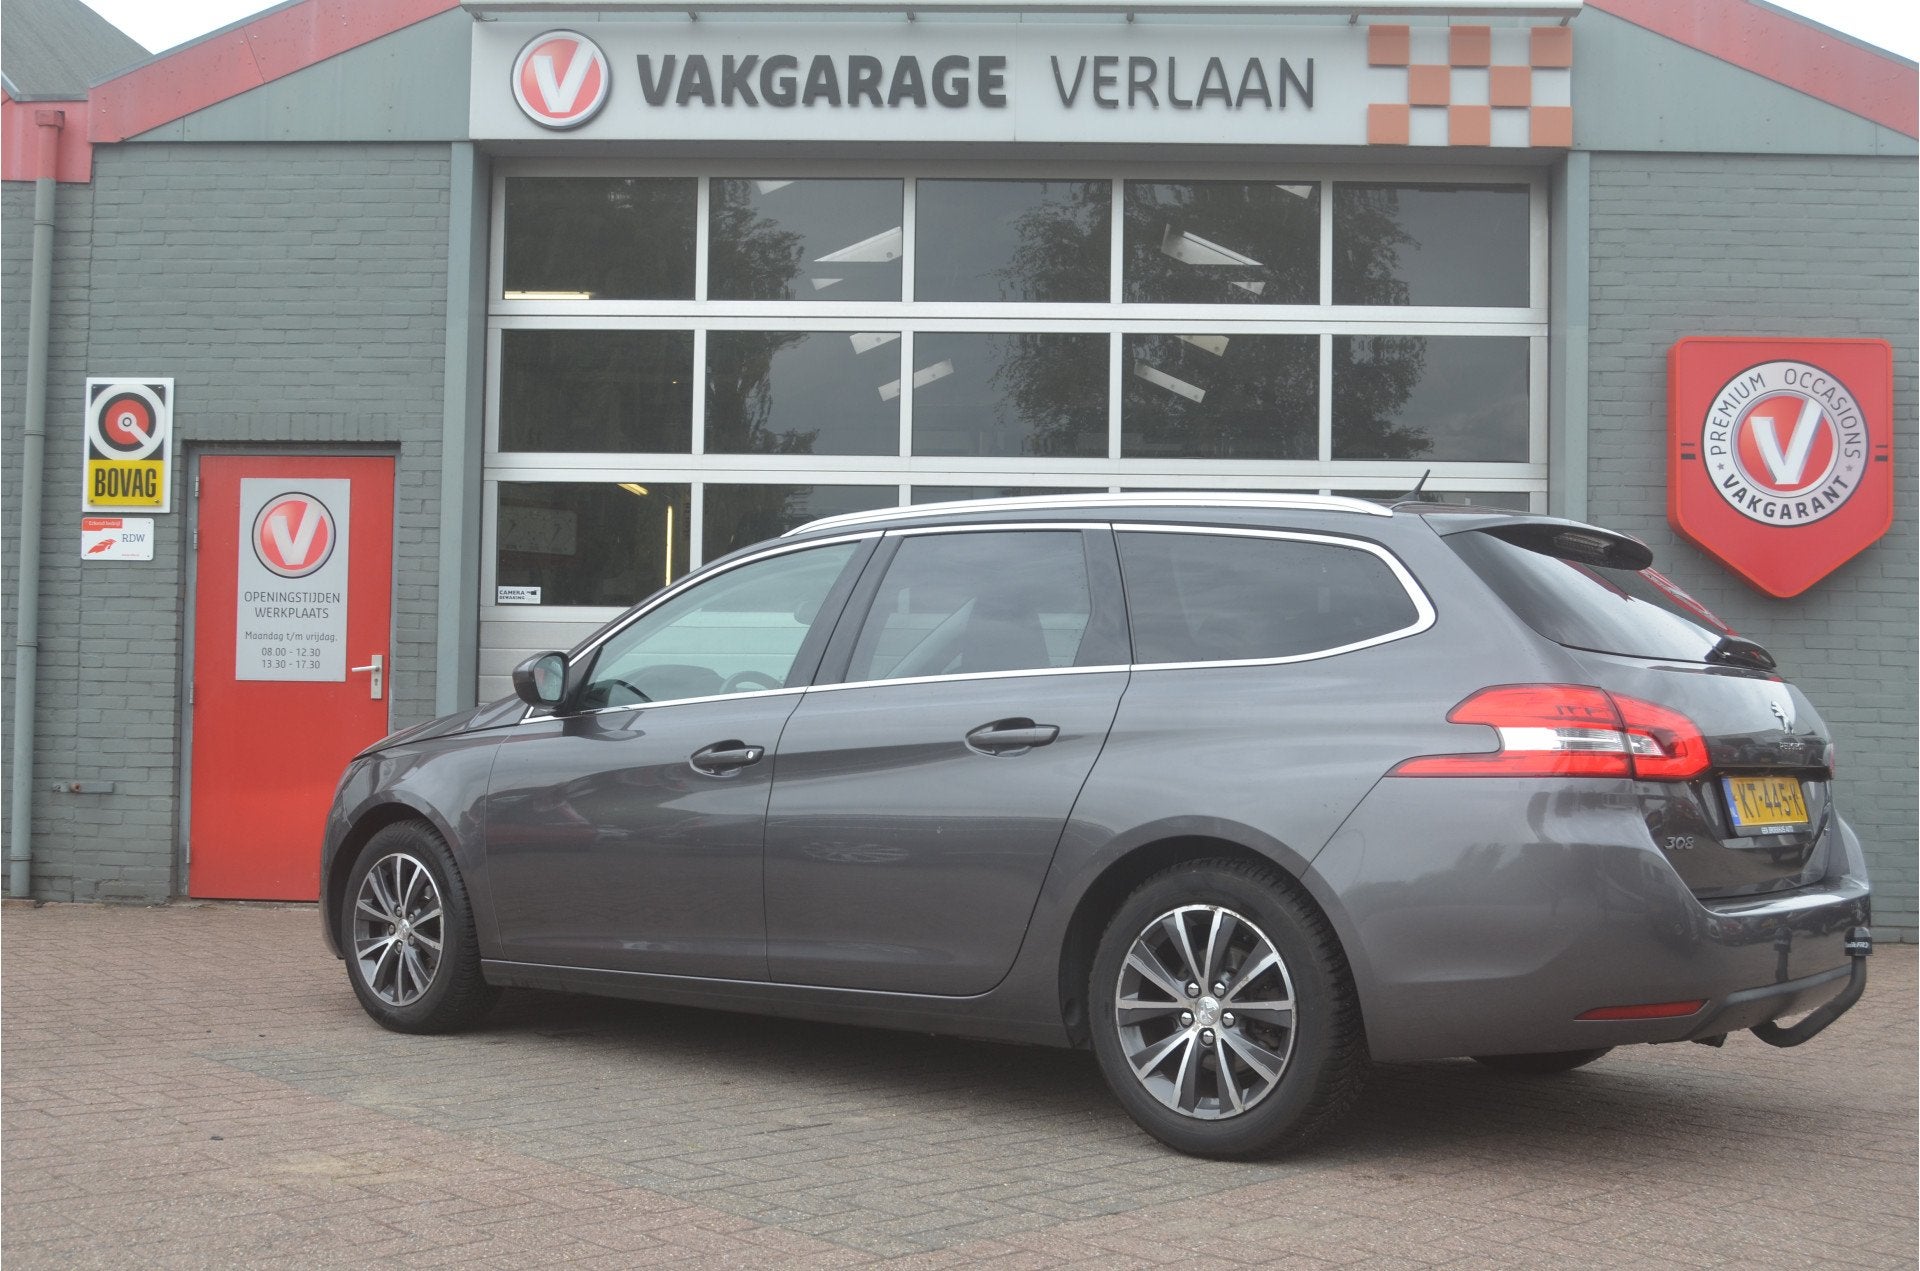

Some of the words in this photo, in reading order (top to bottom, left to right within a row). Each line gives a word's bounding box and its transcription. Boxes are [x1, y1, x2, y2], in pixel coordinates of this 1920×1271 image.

[636, 54, 1008, 107] VAKGARAGE
[1050, 55, 1314, 109] VERLAAN
[1710, 373, 1766, 456] PREMIUM
[1784, 368, 1861, 459] OCCASIONS
[94, 468, 157, 498] BOVAG
[1723, 474, 1848, 520] VAKGARANT
[121, 533, 146, 543] RDW
[244, 591, 341, 604] OPENINGSTIJDEN
[255, 607, 329, 619] WERKPLAATS
[245, 631, 284, 642] Maandag
[286, 632, 304, 641] t/m
[261, 647, 287, 657] 08.00
[296, 648, 321, 658] 12.30
[261, 659, 287, 669] 13.30
[296, 660, 321, 669] 17.30
[1736, 782, 1804, 819] KT-445-K
[1664, 836, 1695, 850] 308
